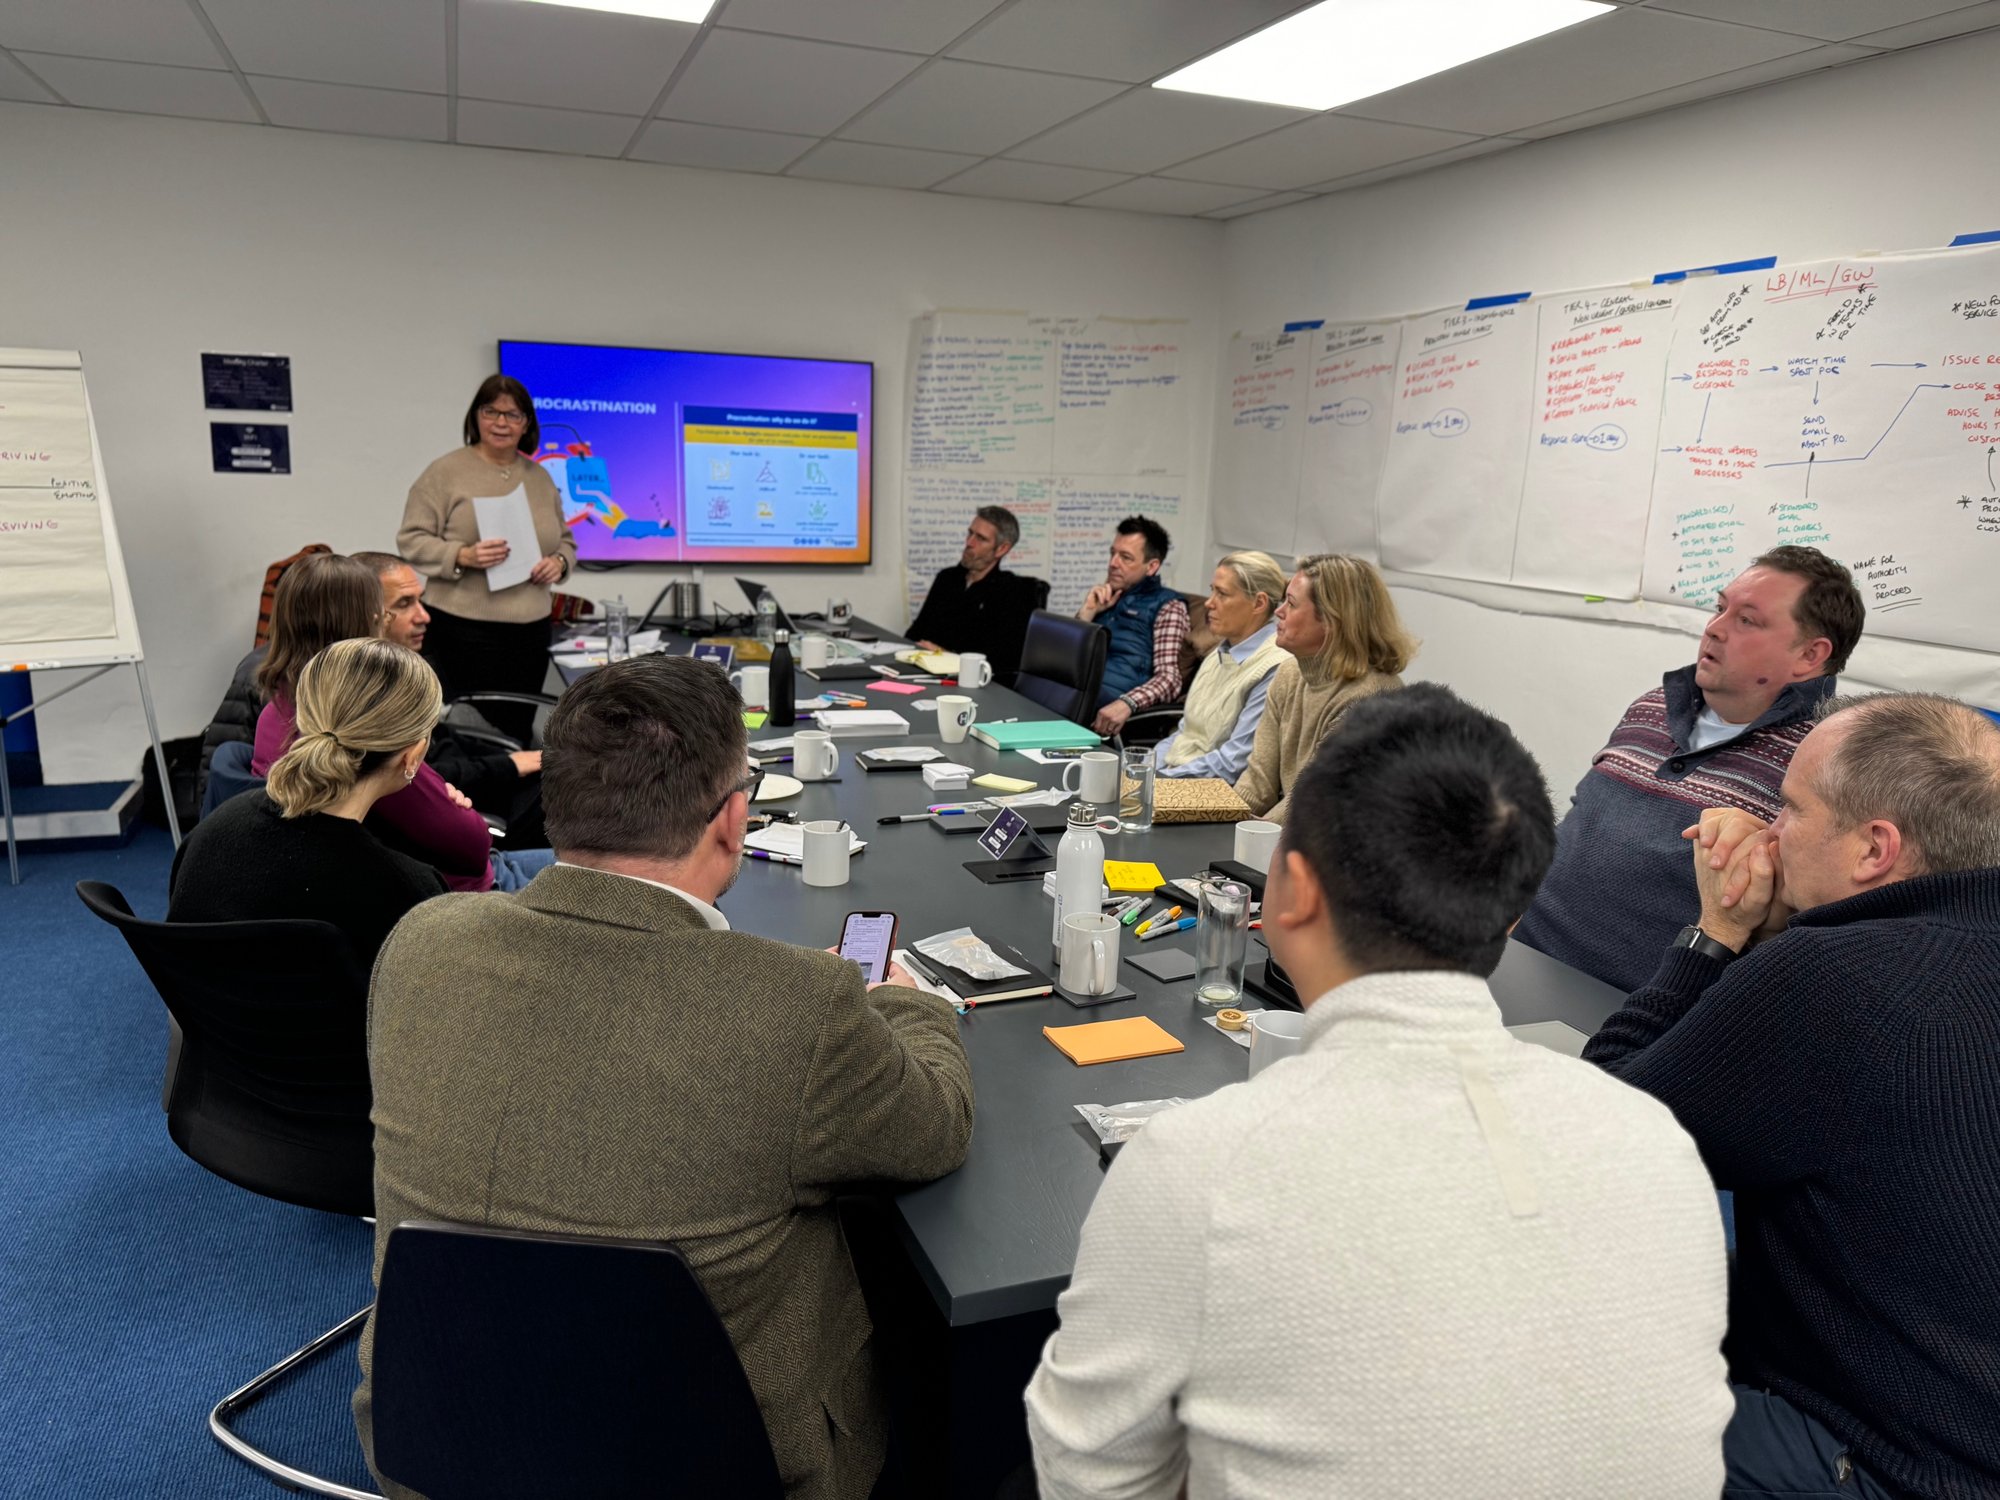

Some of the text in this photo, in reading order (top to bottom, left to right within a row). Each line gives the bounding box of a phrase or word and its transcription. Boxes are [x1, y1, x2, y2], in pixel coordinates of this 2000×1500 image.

[1964, 300, 1987, 310] NEW
[1963, 309, 1998, 320] SERVICE
[1788, 356, 1847, 366] WATCH TIME
[1942, 354, 1980, 366] ISSUE
[1953, 382, 1986, 390] CLOSE
[533, 397, 656, 414] ROCRASTINATION
[1947, 408, 1980, 417] ADVISE
[1962, 421, 1987, 430] HOURS
[1802, 427, 1830, 436] EMAIL
[1853, 554, 1895, 570] NAME FOR
[1867, 566, 1907, 580] AUTHORITY
[1876, 586, 1911, 600] PROCEED
